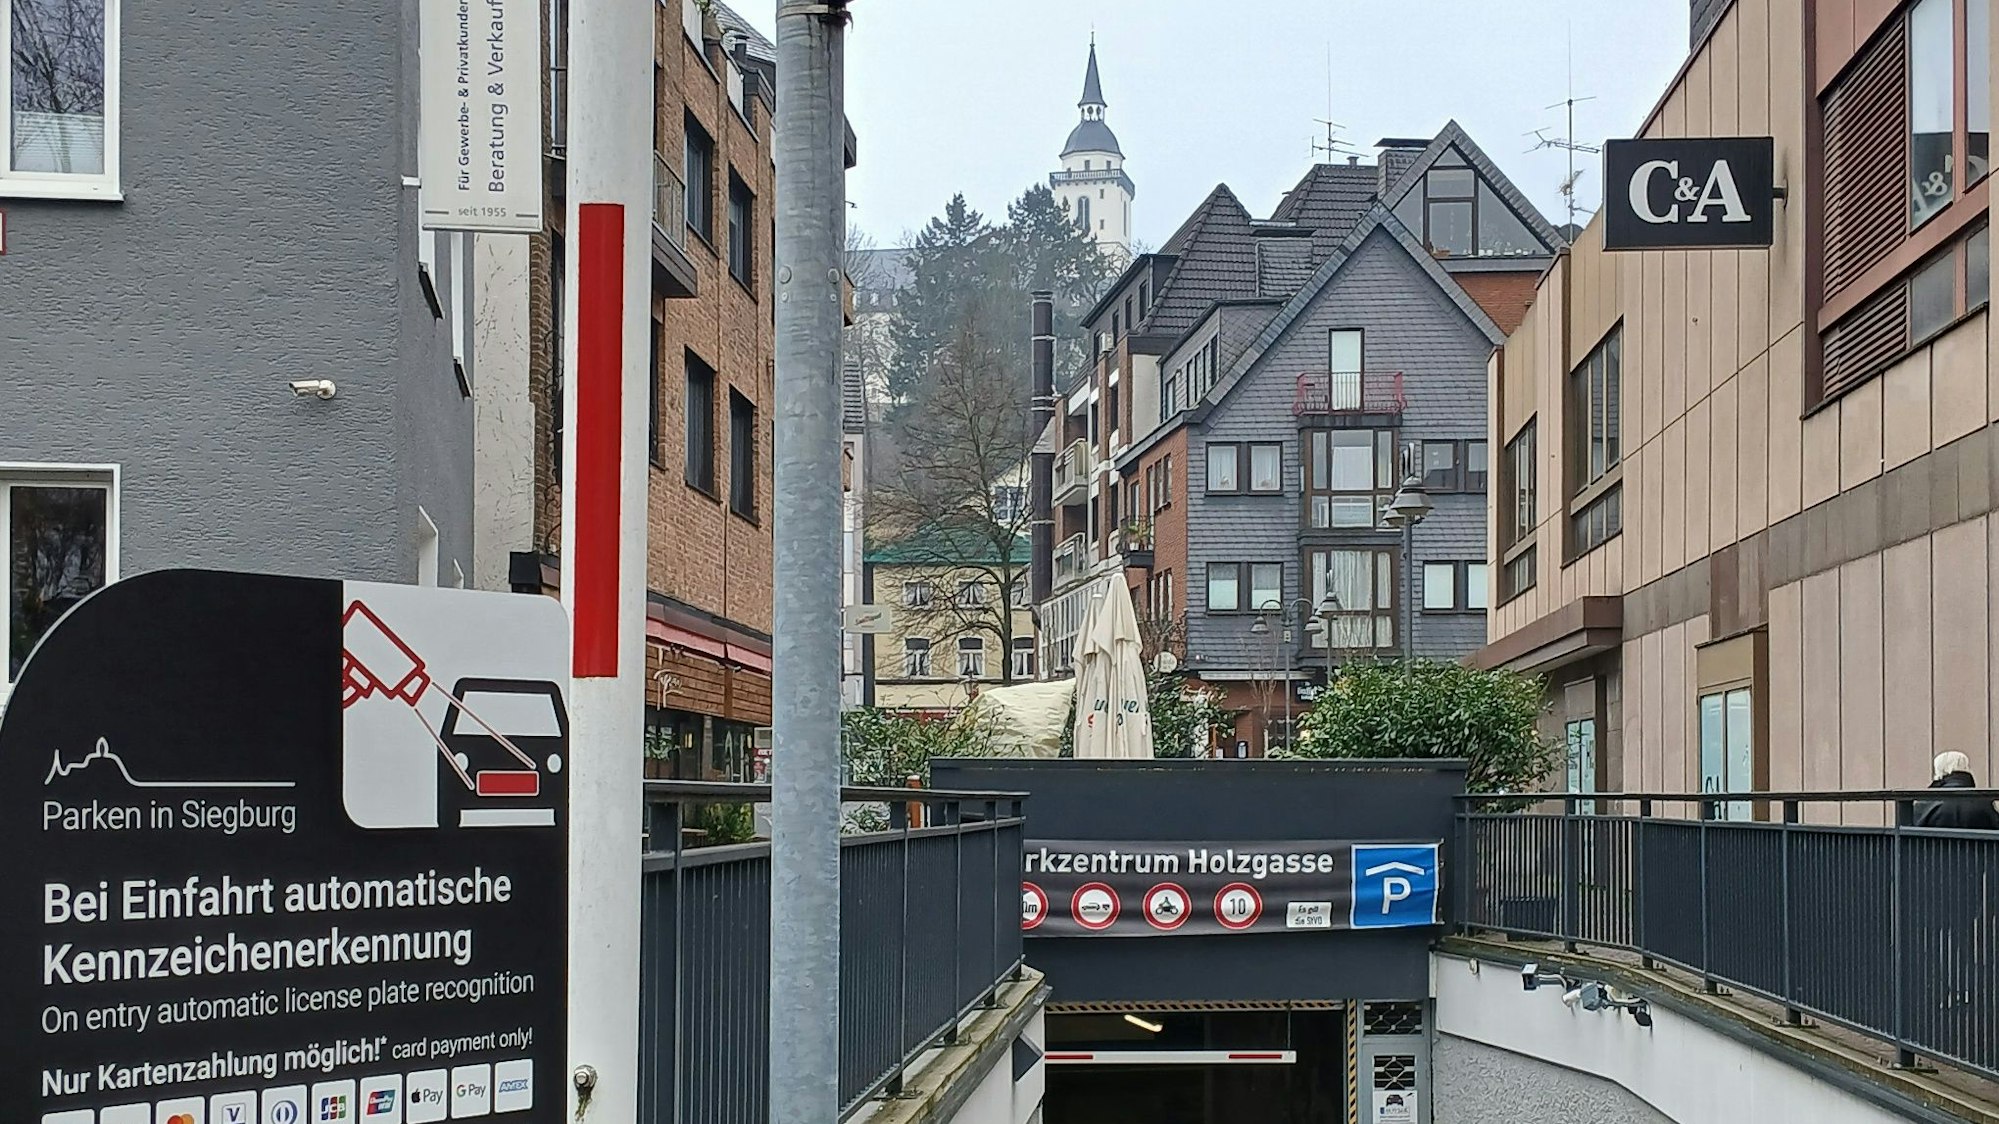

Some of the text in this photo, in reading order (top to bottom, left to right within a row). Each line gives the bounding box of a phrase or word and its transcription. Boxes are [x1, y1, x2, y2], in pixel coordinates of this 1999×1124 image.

[457, 88, 470, 98] &
[486, 0, 509, 193] Beratung & Verkauf
[457, 101, 470, 166] Gewerbe-
[457, 170, 470, 191] Für
[1629, 159, 1752, 223] C&A
[457, 206, 507, 218] seit 1955
[43, 798, 296, 835] Parken in Siegburg
[1025, 848, 1334, 879] rkzentrum Holzgasse
[44, 866, 512, 923] Bei Einfahrt automatische
[1229, 897, 1247, 917] 10
[1382, 877, 1411, 915] P
[43, 927, 472, 985] Kennzeichenerkennung
[41, 970, 534, 1034] On entry automatic license plate recognition
[42, 1069, 92, 1097] Nur
[98, 1048, 278, 1090] Kartenzahlung
[392, 1036, 427, 1060] card
[430, 1031, 496, 1060] payment
[499, 1026, 534, 1050] only!
[423, 1088, 443, 1105] Pay
[456, 1083, 486, 1098] G Pay
[498, 1079, 529, 1093] AMEX
